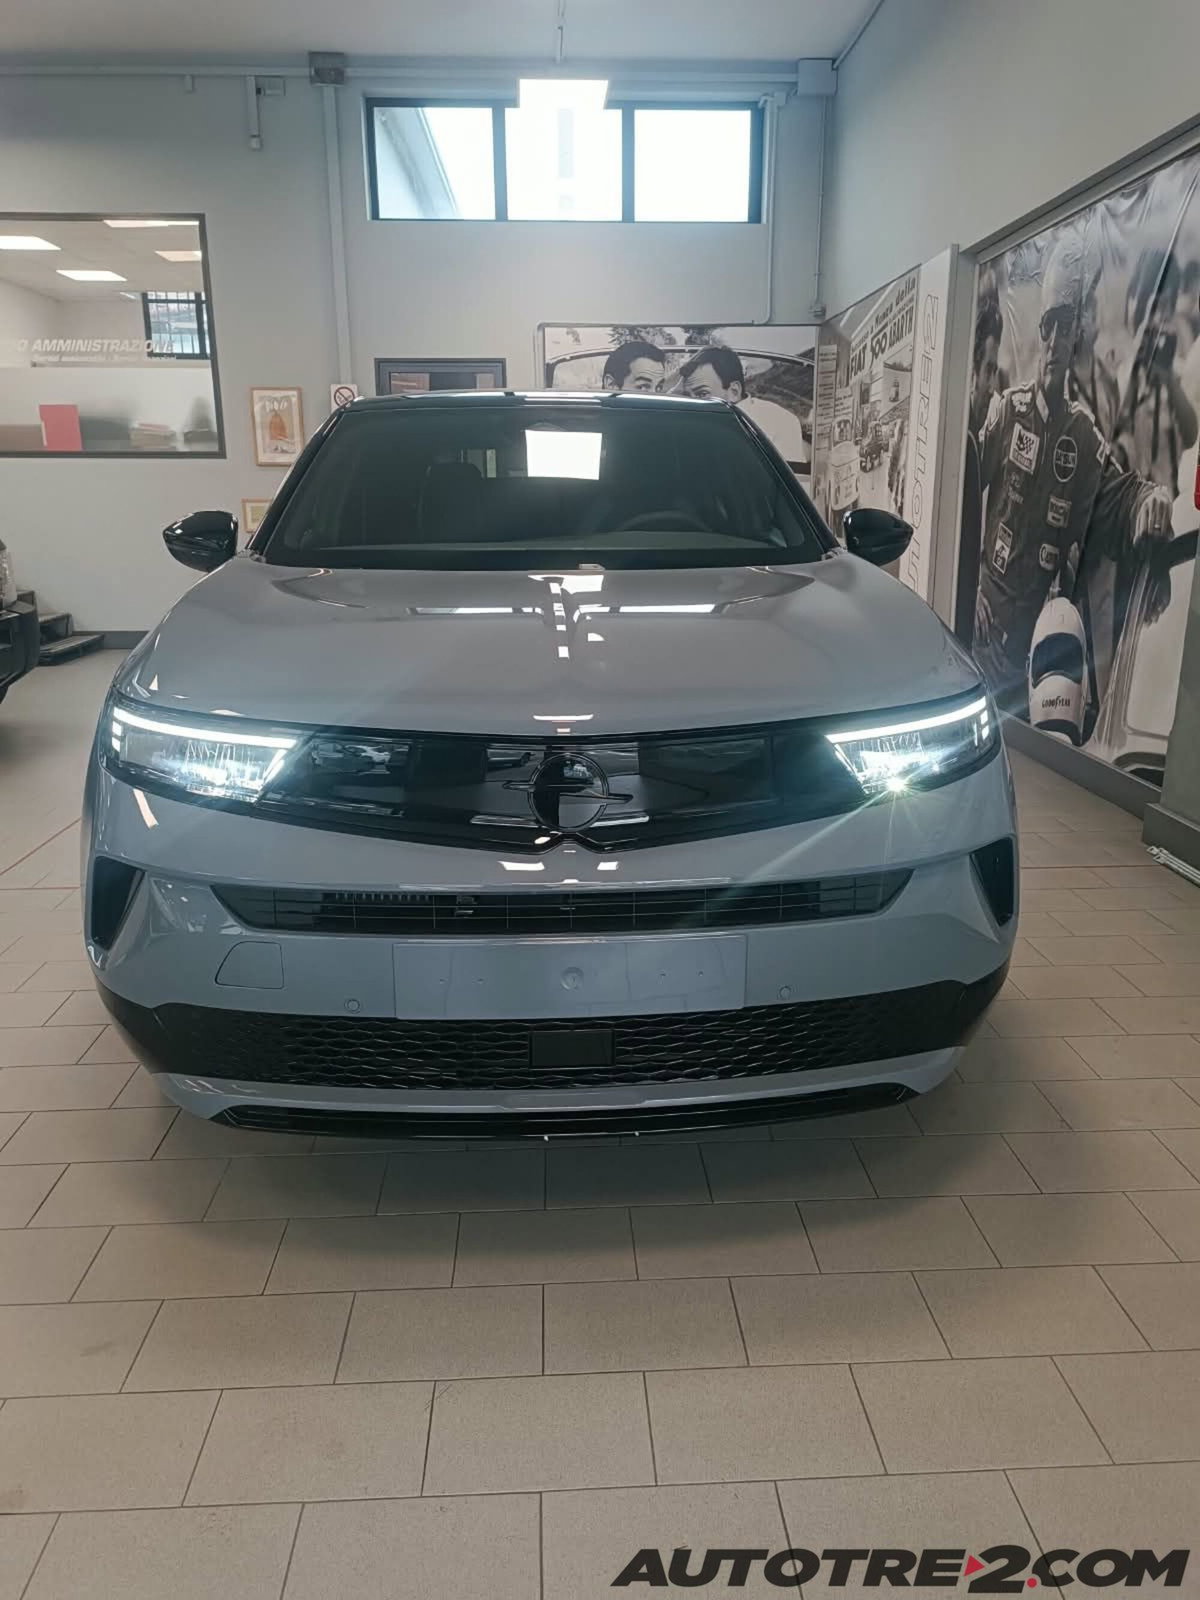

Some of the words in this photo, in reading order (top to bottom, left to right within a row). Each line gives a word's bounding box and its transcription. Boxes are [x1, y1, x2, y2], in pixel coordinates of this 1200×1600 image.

[850, 343, 867, 380] FIAT
[871, 321, 888, 370] 500
[889, 304, 914, 350] ABARTH
